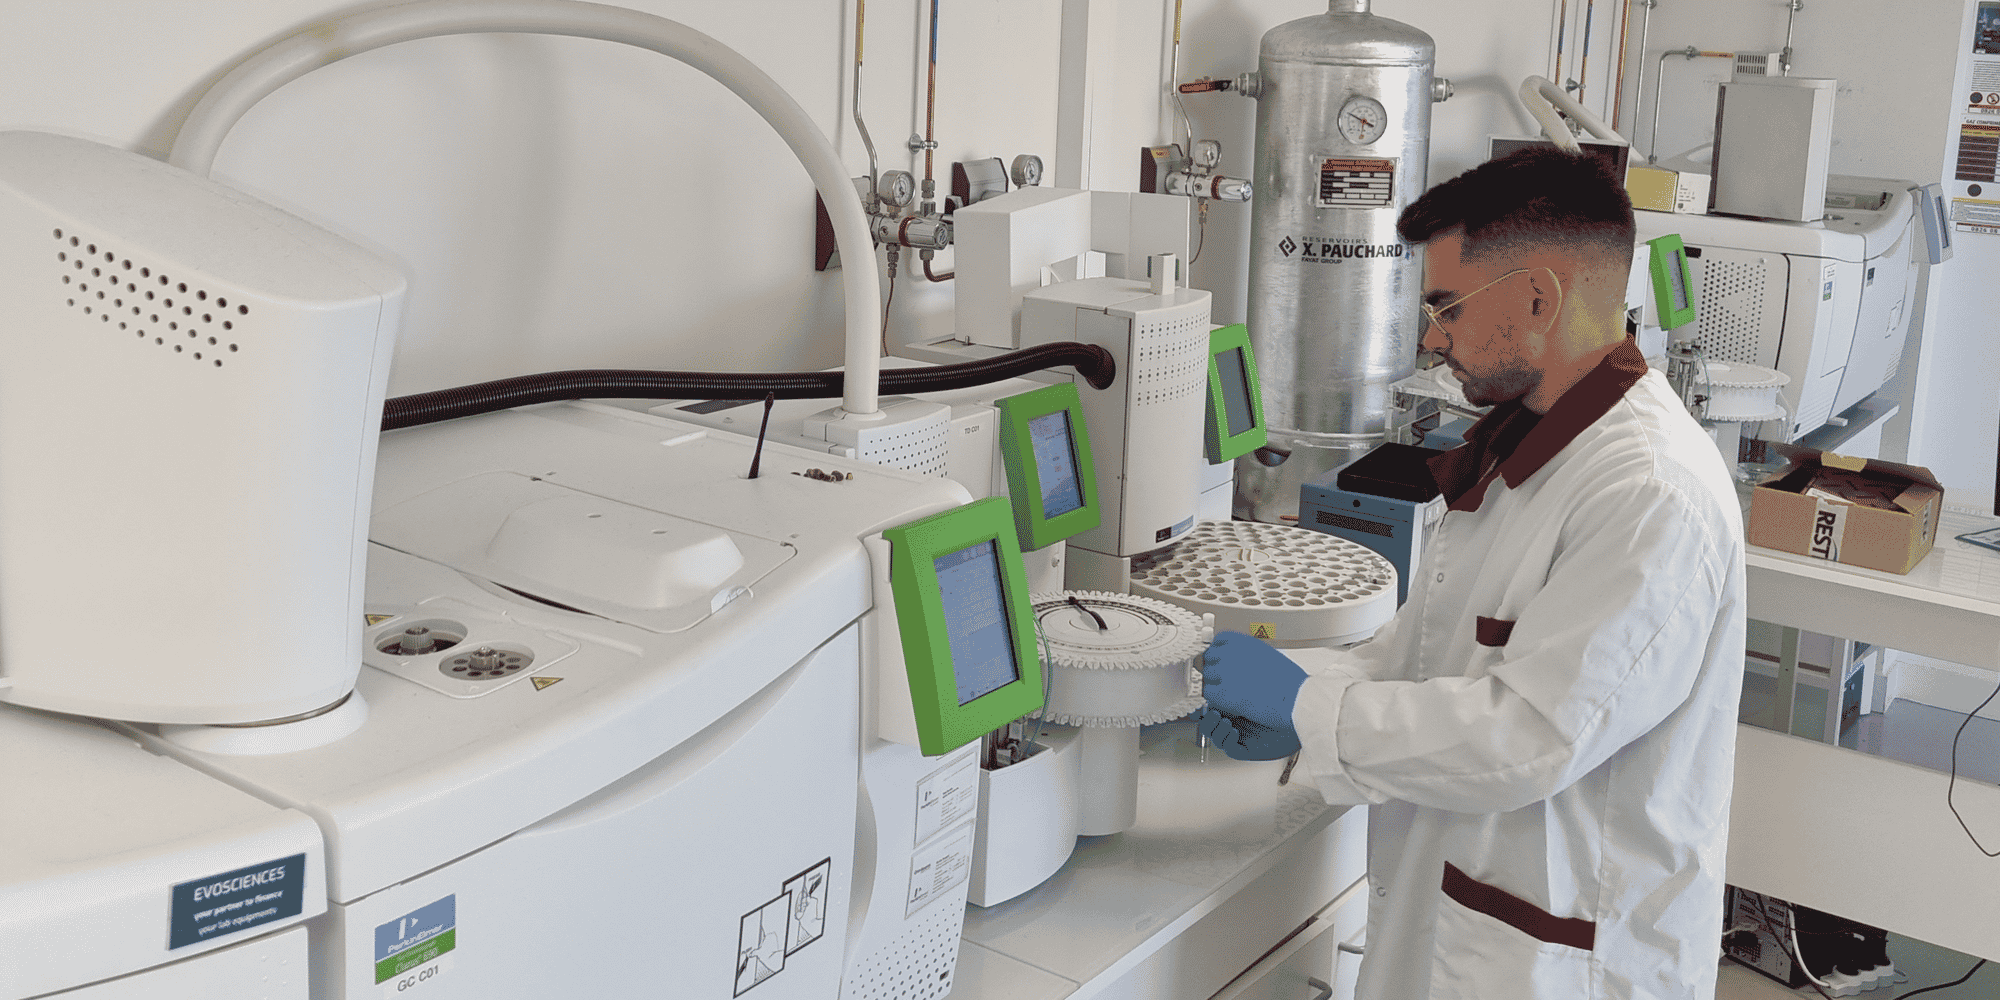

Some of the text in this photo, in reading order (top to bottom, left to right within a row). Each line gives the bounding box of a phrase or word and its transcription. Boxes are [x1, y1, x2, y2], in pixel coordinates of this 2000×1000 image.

[1302, 236, 1368, 245] RESERVOIRS
[1302, 242, 1403, 259] X. PAUCHARD
[1812, 510, 1836, 559] REST
[193, 865, 286, 903] EVOSCIENCES
[193, 908, 214, 923] your
[198, 922, 218, 937] your
[387, 923, 444, 954] PerkinElmer
[397, 964, 439, 992] GC C01
